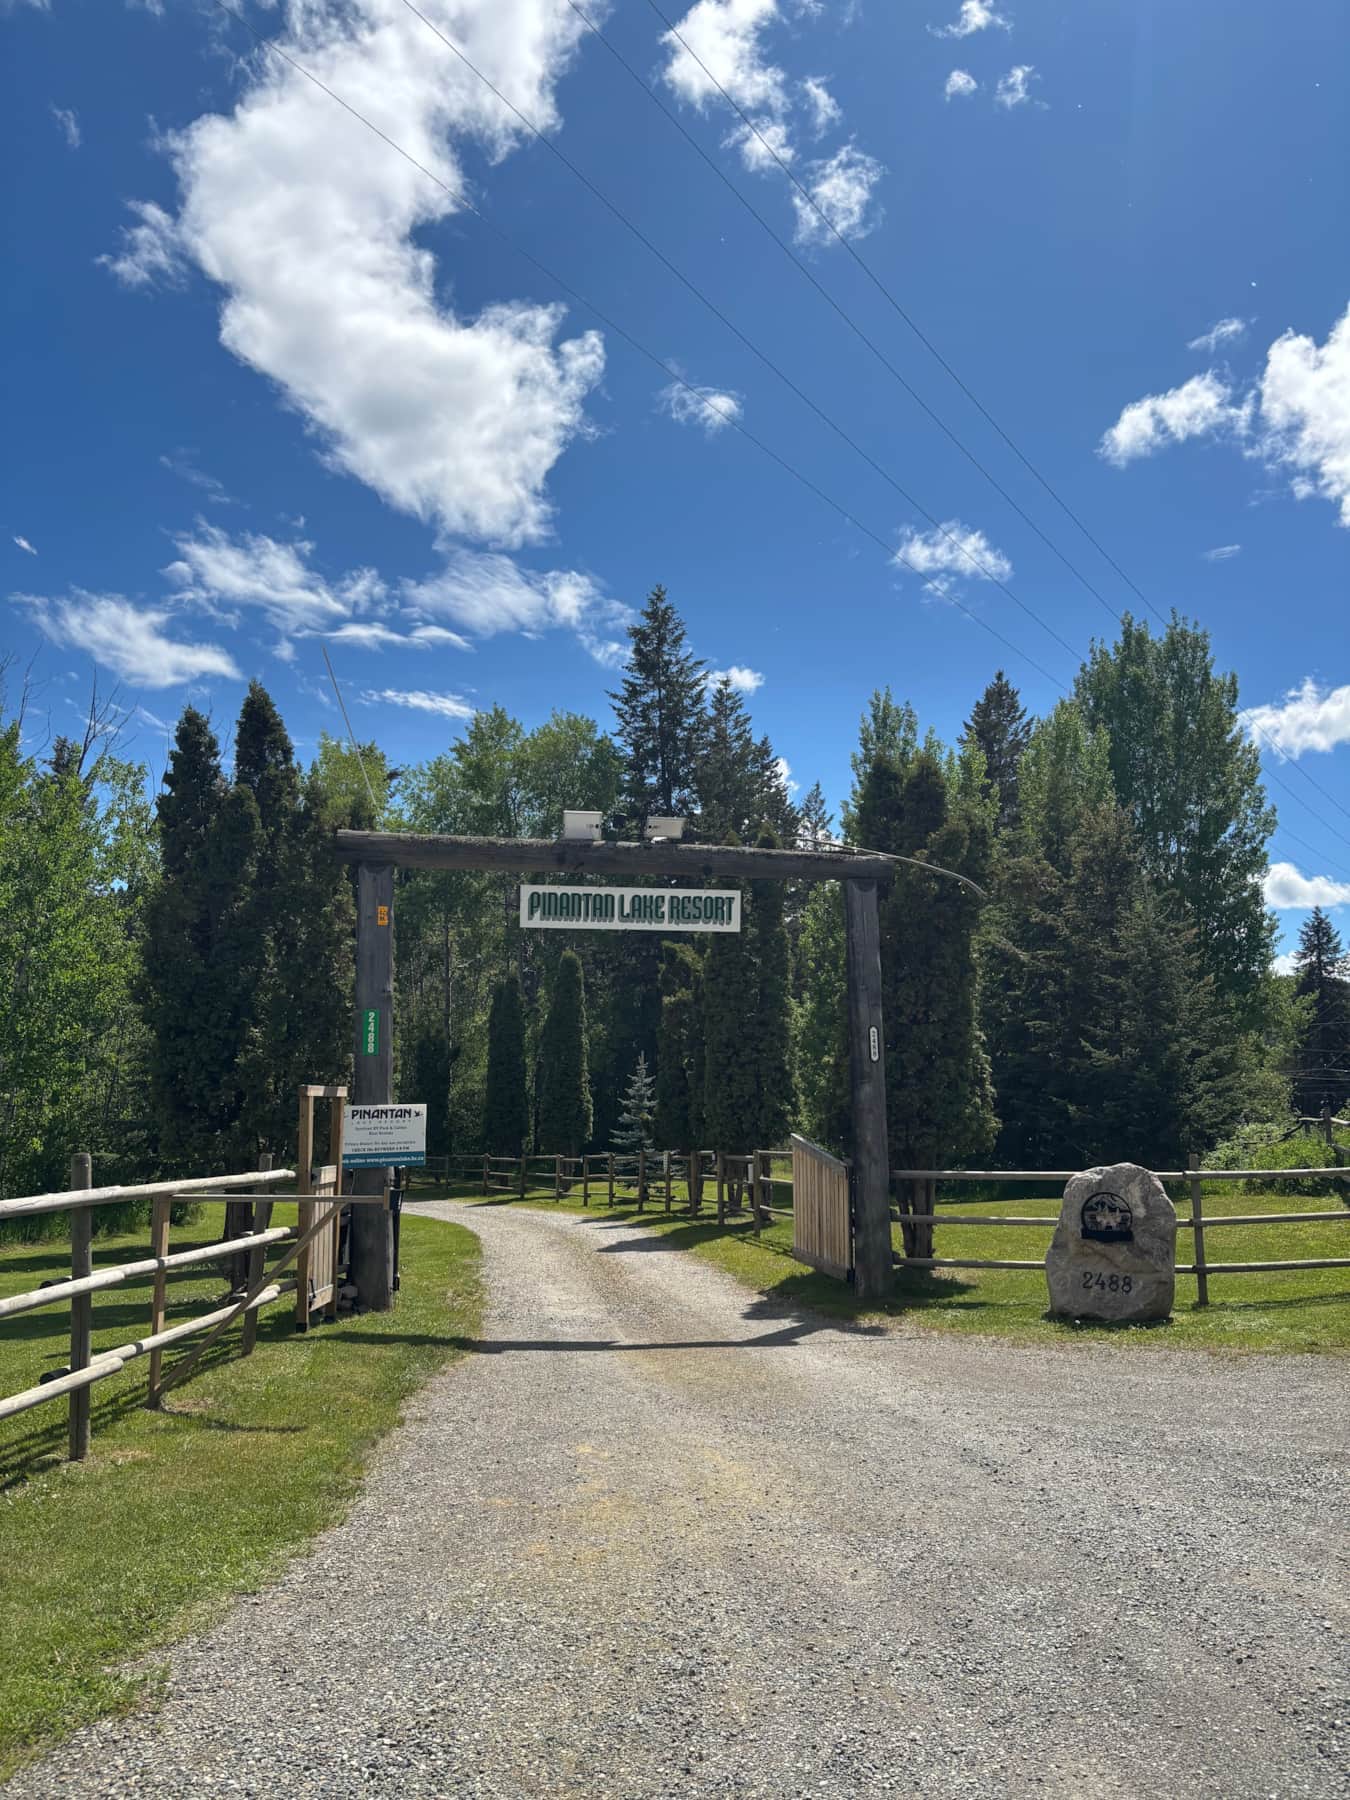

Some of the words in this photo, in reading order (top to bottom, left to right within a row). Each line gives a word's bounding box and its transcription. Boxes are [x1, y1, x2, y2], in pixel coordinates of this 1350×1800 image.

[528, 891, 615, 922] PINANTAN
[617, 894, 666, 924] LAKE
[668, 895, 735, 926] RESORT
[367, 1011, 376, 1054] 2488
[351, 1109, 412, 1120] PINANTAN
[1082, 1271, 1132, 1293] 2488
